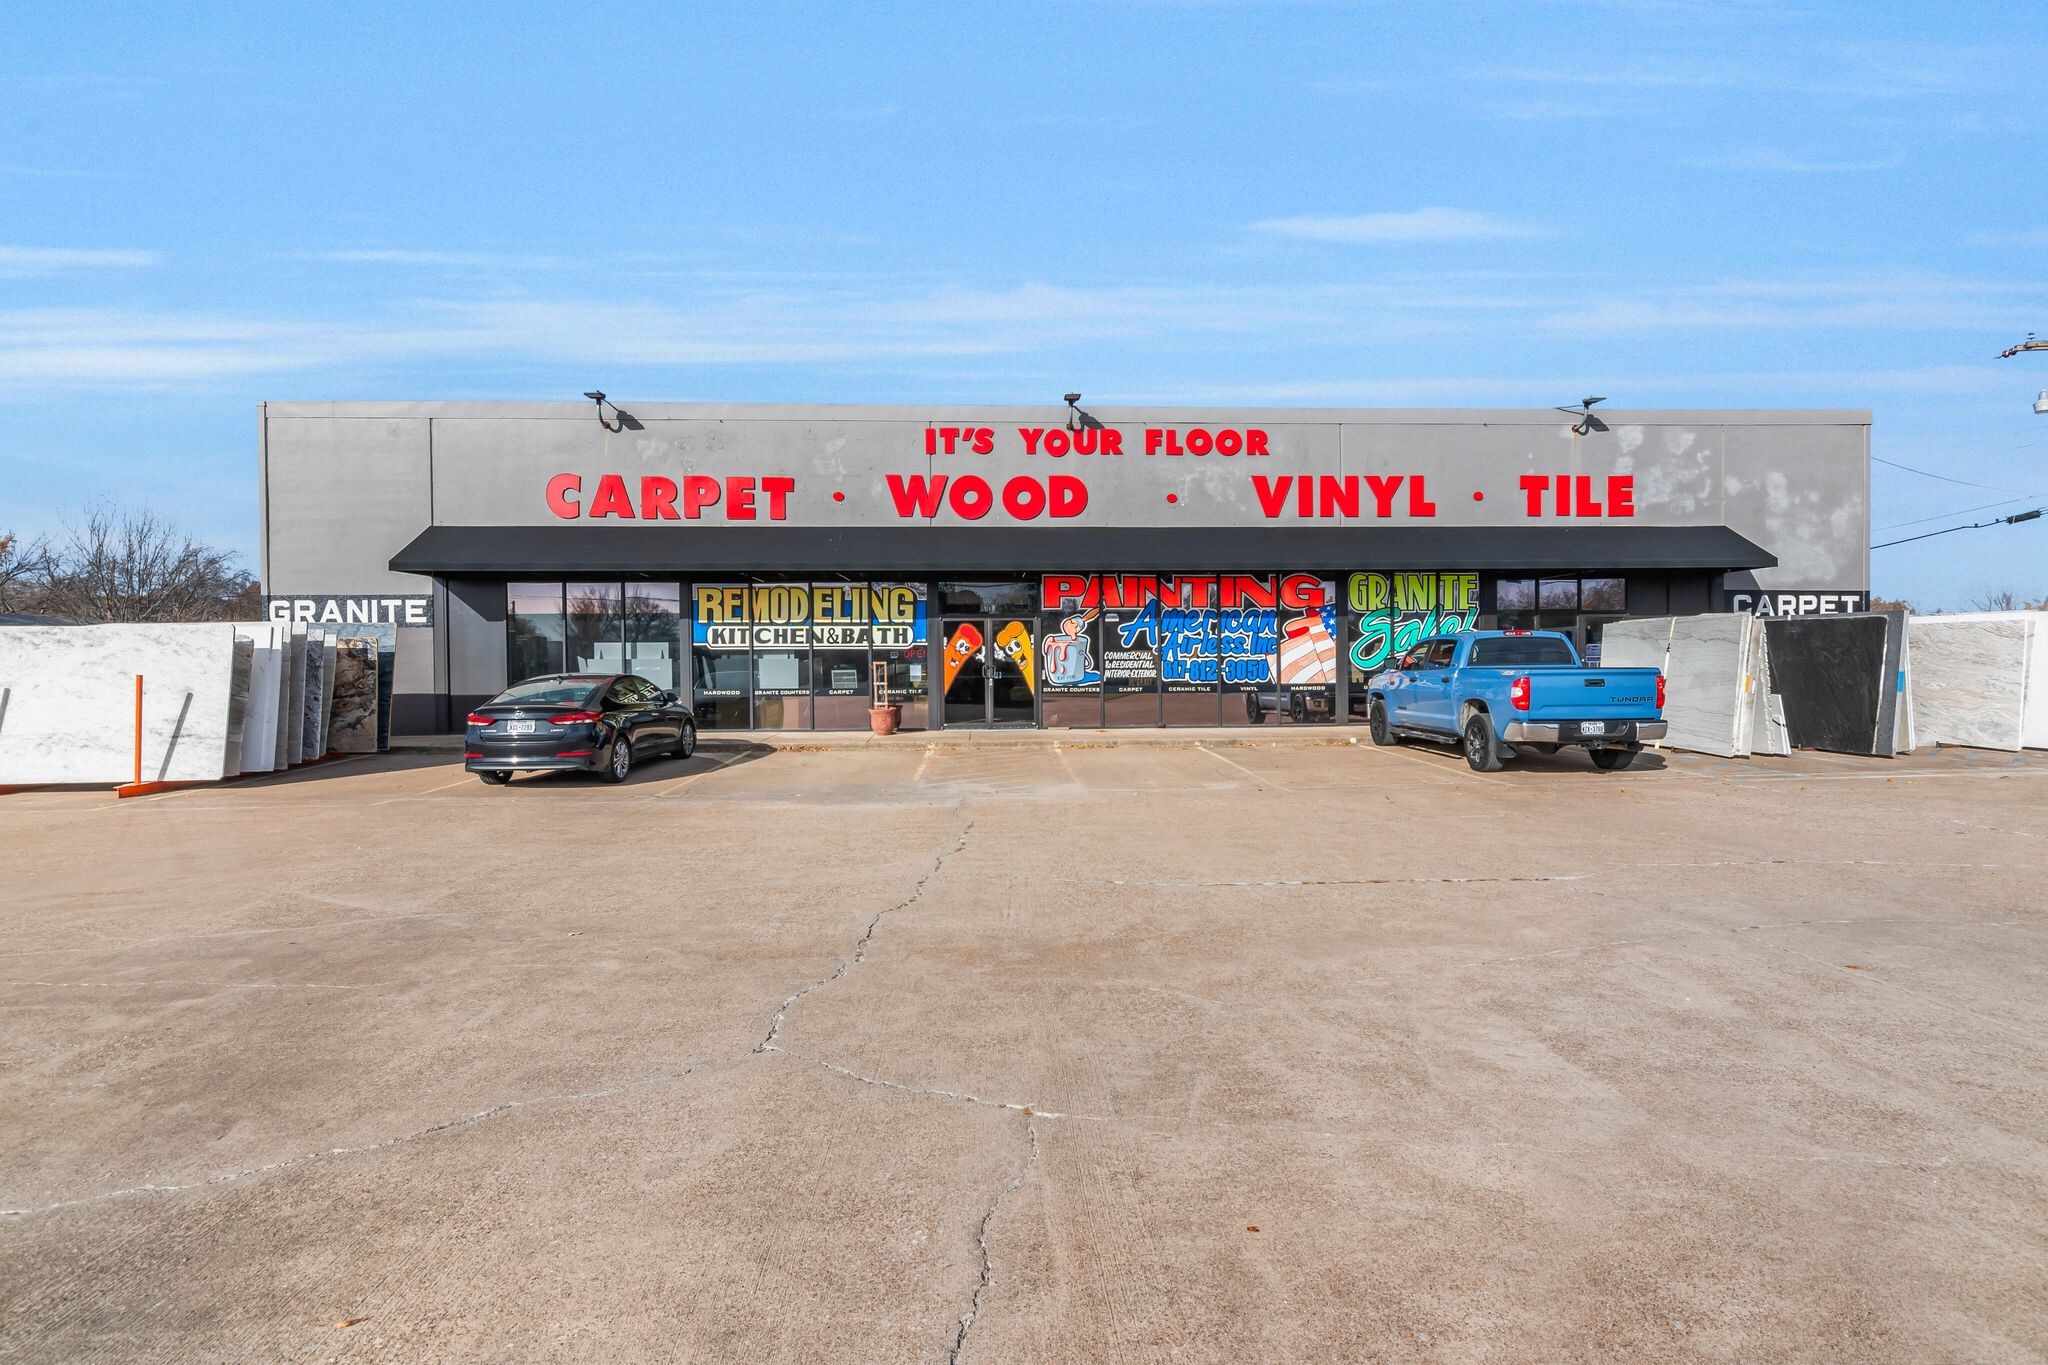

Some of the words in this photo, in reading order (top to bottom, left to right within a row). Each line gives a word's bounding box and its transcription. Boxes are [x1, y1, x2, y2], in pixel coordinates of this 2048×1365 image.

[925, 426, 995, 456] IT'S
[1018, 427, 1123, 458] YOUR
[1145, 428, 1270, 457] FLOOR
[545, 473, 795, 521] CARPET
[885, 474, 1088, 521] WOOD
[1251, 474, 1436, 519] VINYL
[1519, 474, 1635, 519] TILE
[268, 599, 427, 623] GRANITE
[697, 586, 915, 625] REMODELING
[1042, 574, 1326, 612] PAINTING
[1348, 572, 1479, 612] GRANITE
[1733, 594, 1861, 617] CARPET
[1118, 598, 1279, 646] American
[1104, 651, 1153, 660] COMMERCIAL
[1162, 658, 1271, 683] 817-812-3050
